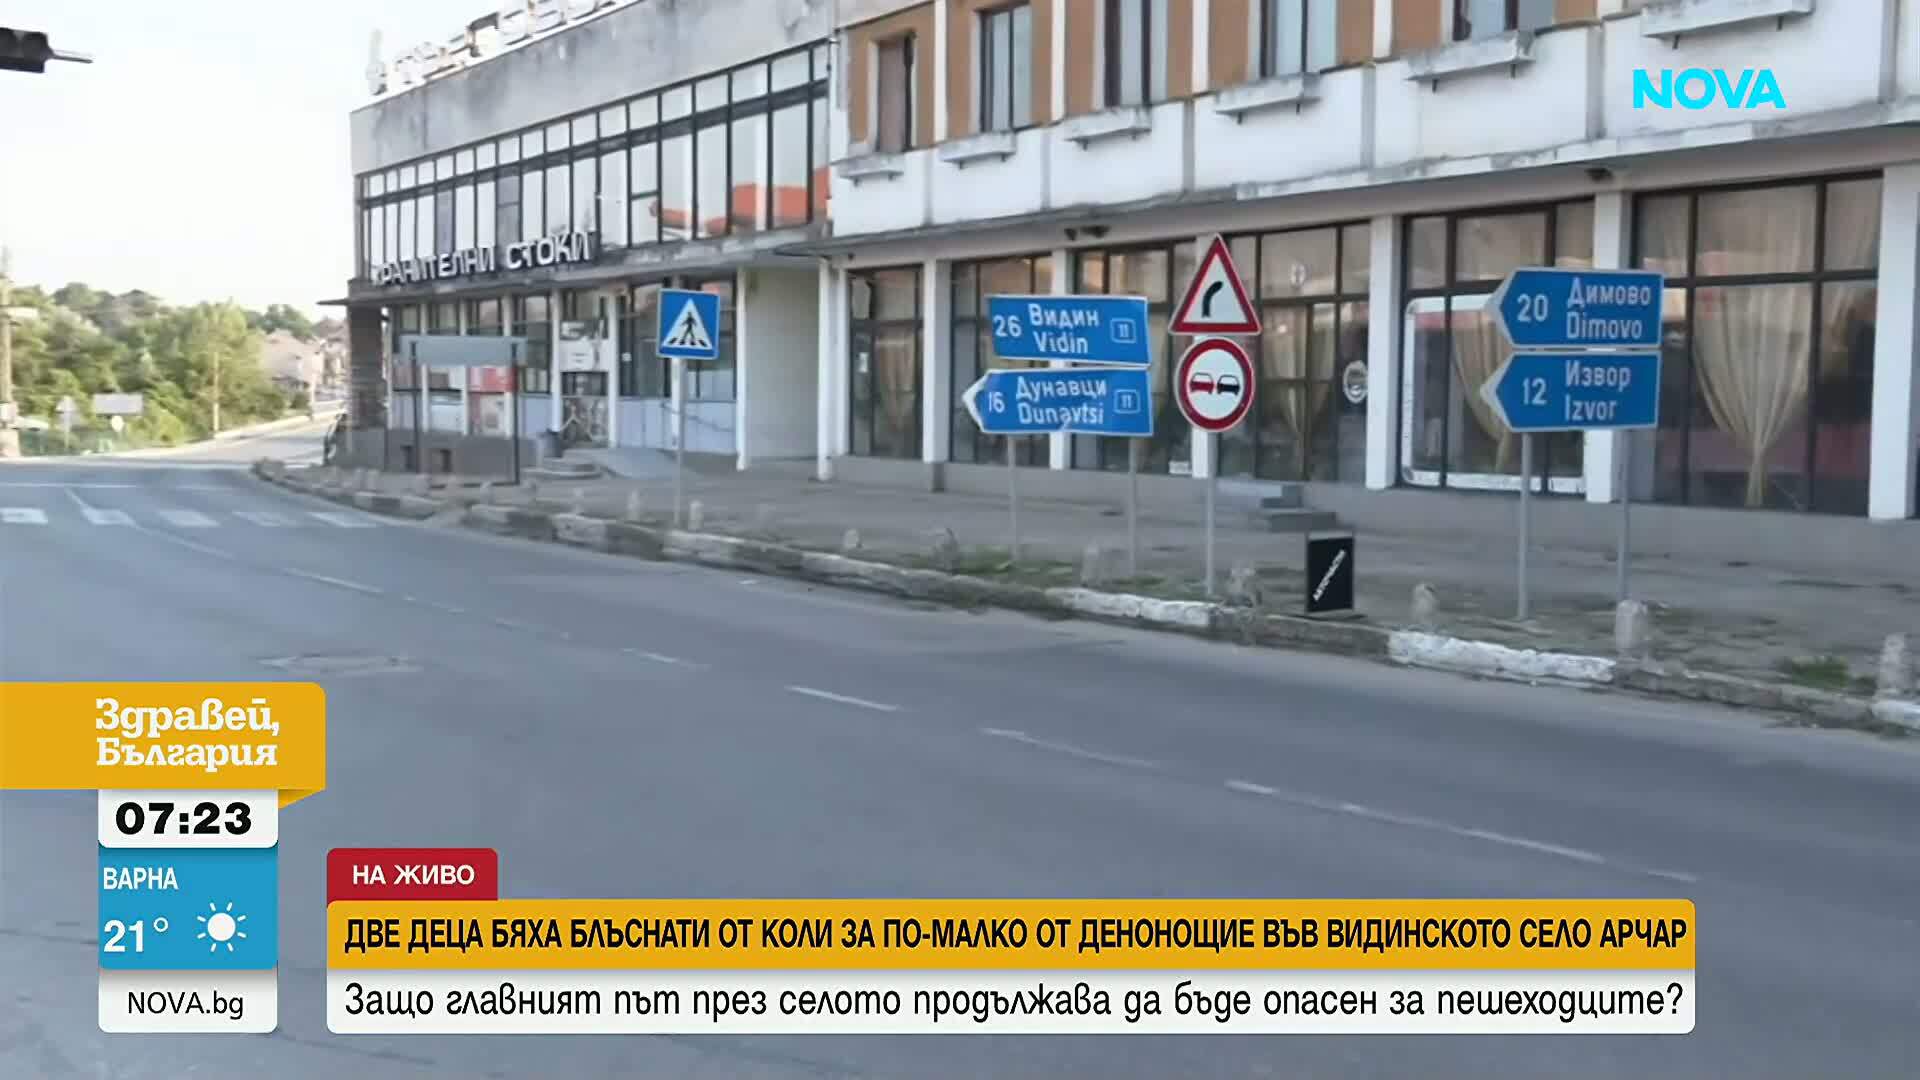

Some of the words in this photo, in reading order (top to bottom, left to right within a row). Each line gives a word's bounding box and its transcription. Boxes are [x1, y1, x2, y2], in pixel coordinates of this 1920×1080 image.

[505, 231, 591, 269] СТОКИ
[1566, 277, 1651, 308] Димово
[1028, 303, 1099, 328] Видин
[1516, 293, 1549, 323] 20
[992, 314, 1022, 338] 26
[1566, 311, 1643, 339] Dimovo
[1033, 330, 1089, 355] Vidin
[1015, 375, 1107, 401] Дунавци
[1565, 359, 1631, 392] Извор
[1522, 377, 1548, 406] 12
[1017, 402, 1105, 426] Dunavtsi
[1564, 394, 1617, 421] Izvor
